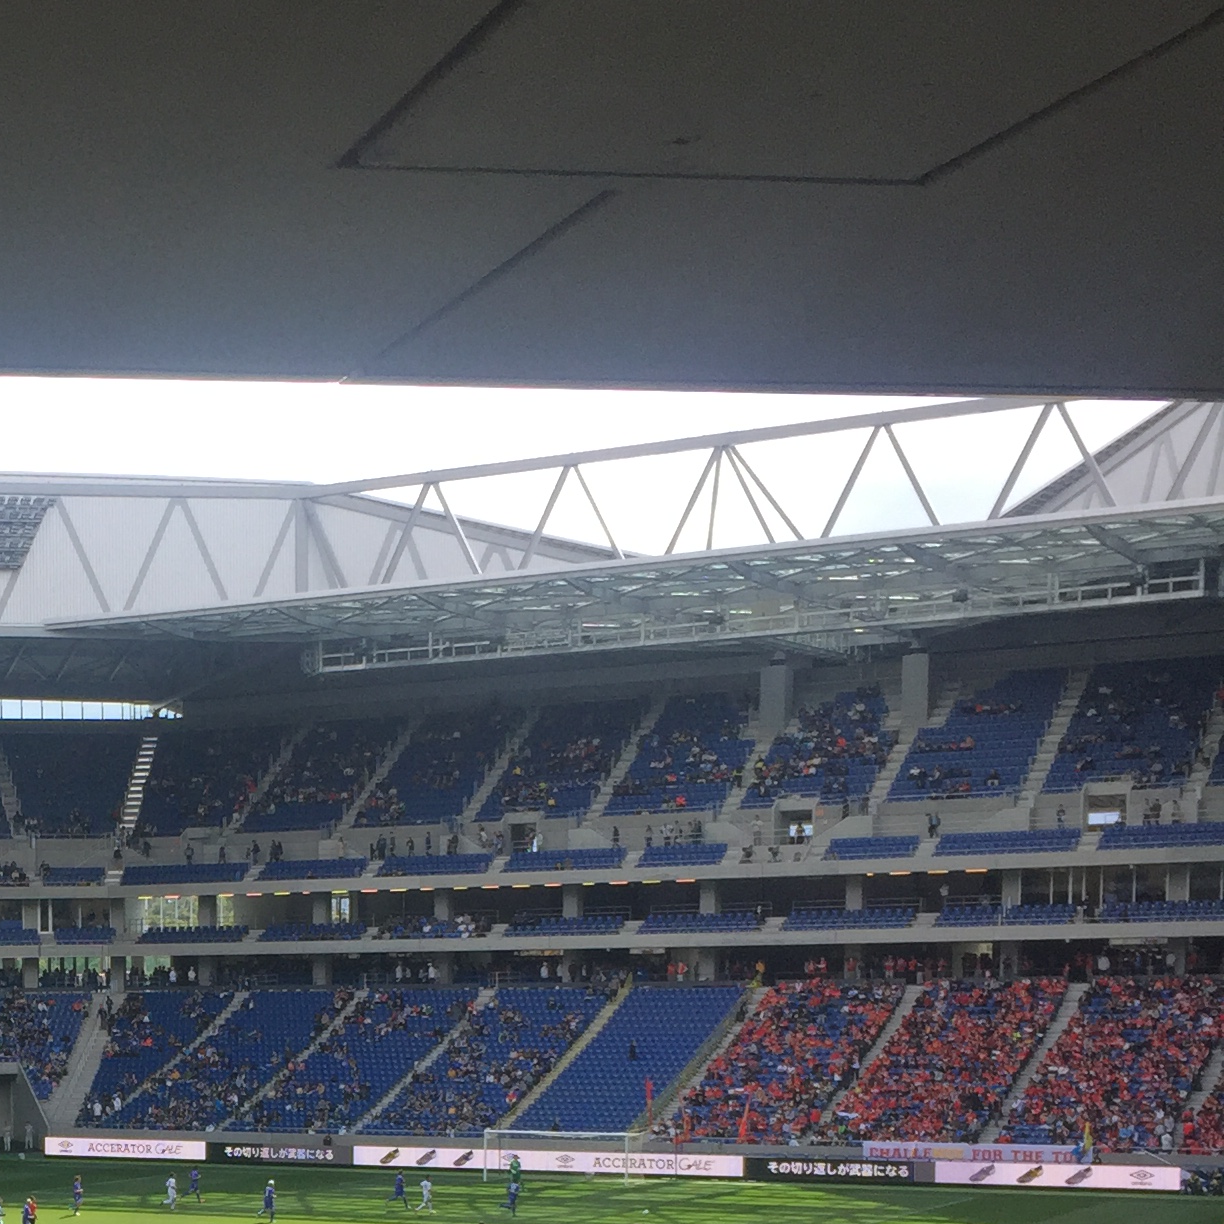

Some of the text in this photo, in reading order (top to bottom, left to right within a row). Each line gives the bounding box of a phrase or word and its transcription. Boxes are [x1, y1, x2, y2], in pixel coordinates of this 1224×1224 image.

[87, 1142, 153, 1155] ACCERATOR
[972, 1149, 1003, 1161] FOR
[1011, 1149, 1044, 1162] THE
